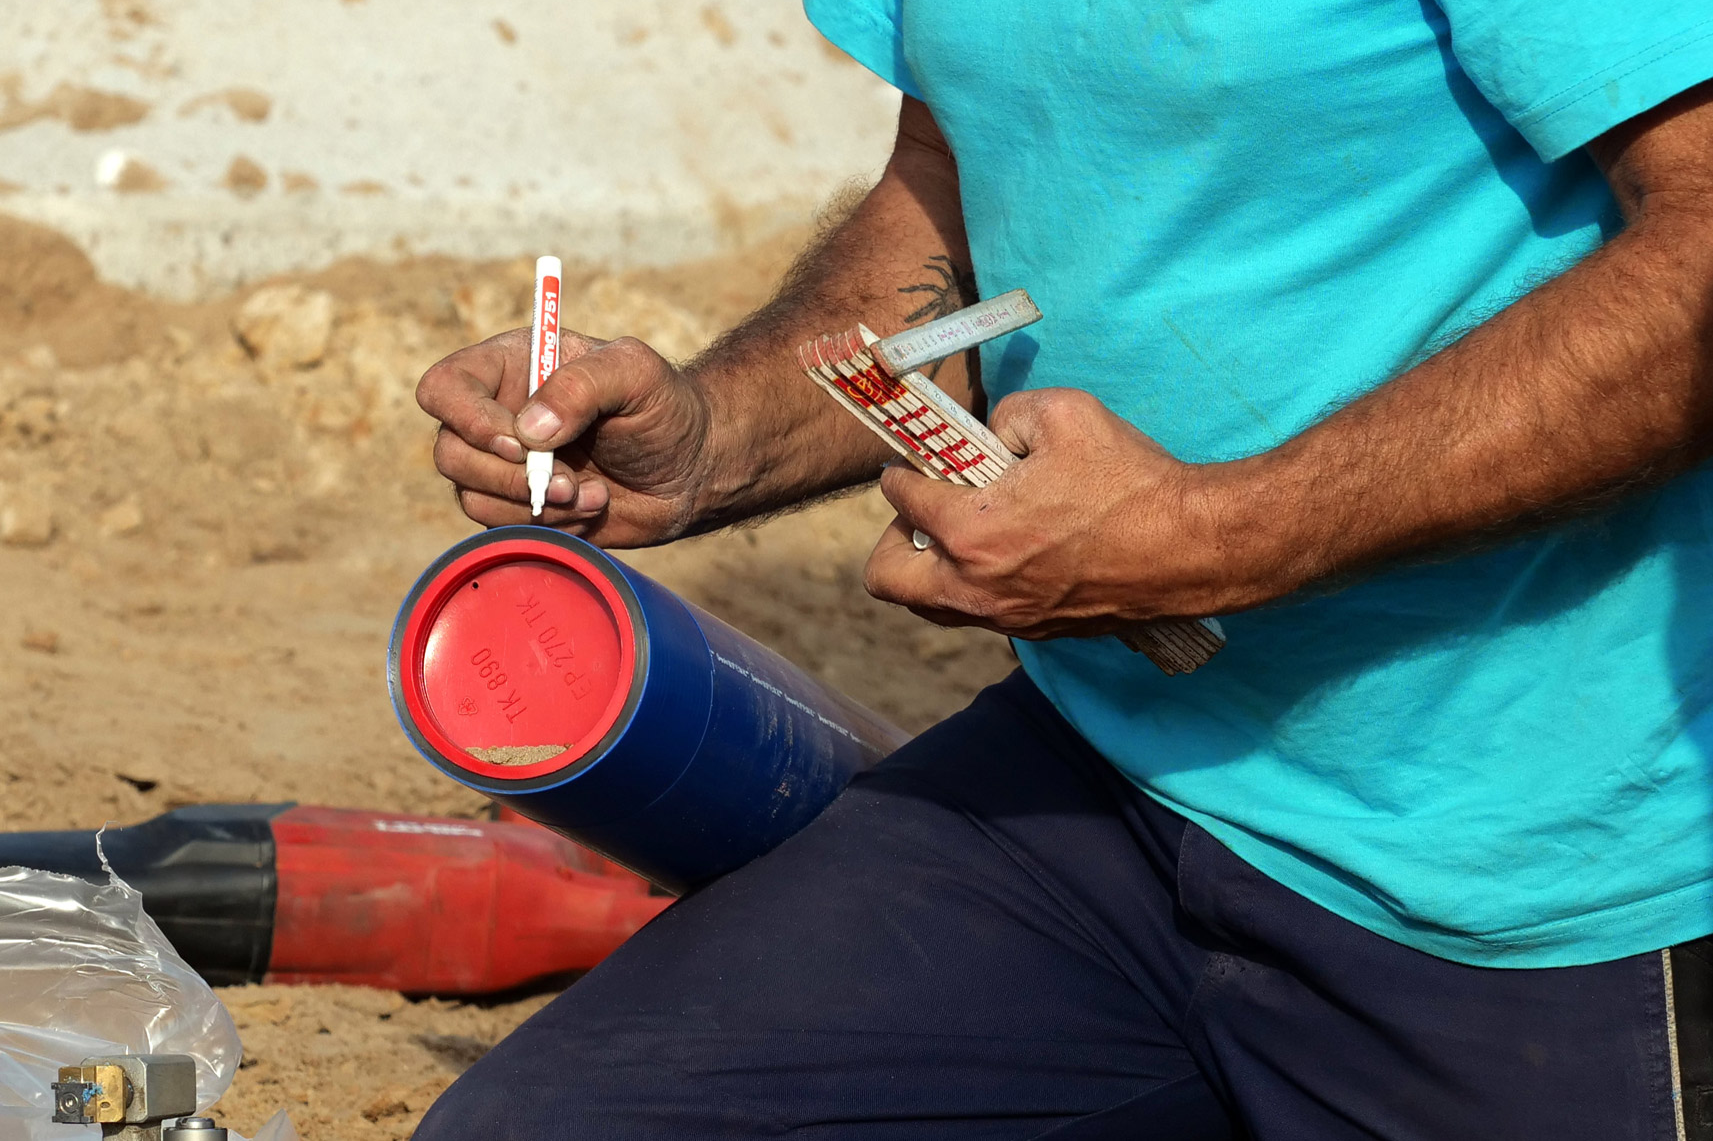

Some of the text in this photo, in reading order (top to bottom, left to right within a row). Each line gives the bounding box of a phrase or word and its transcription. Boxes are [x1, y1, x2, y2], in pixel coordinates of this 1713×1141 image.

[540, 291, 558, 382] dding 751
[516, 596, 546, 628] TK
[538, 626, 574, 668] 270
[471, 648, 528, 724] TK 890
